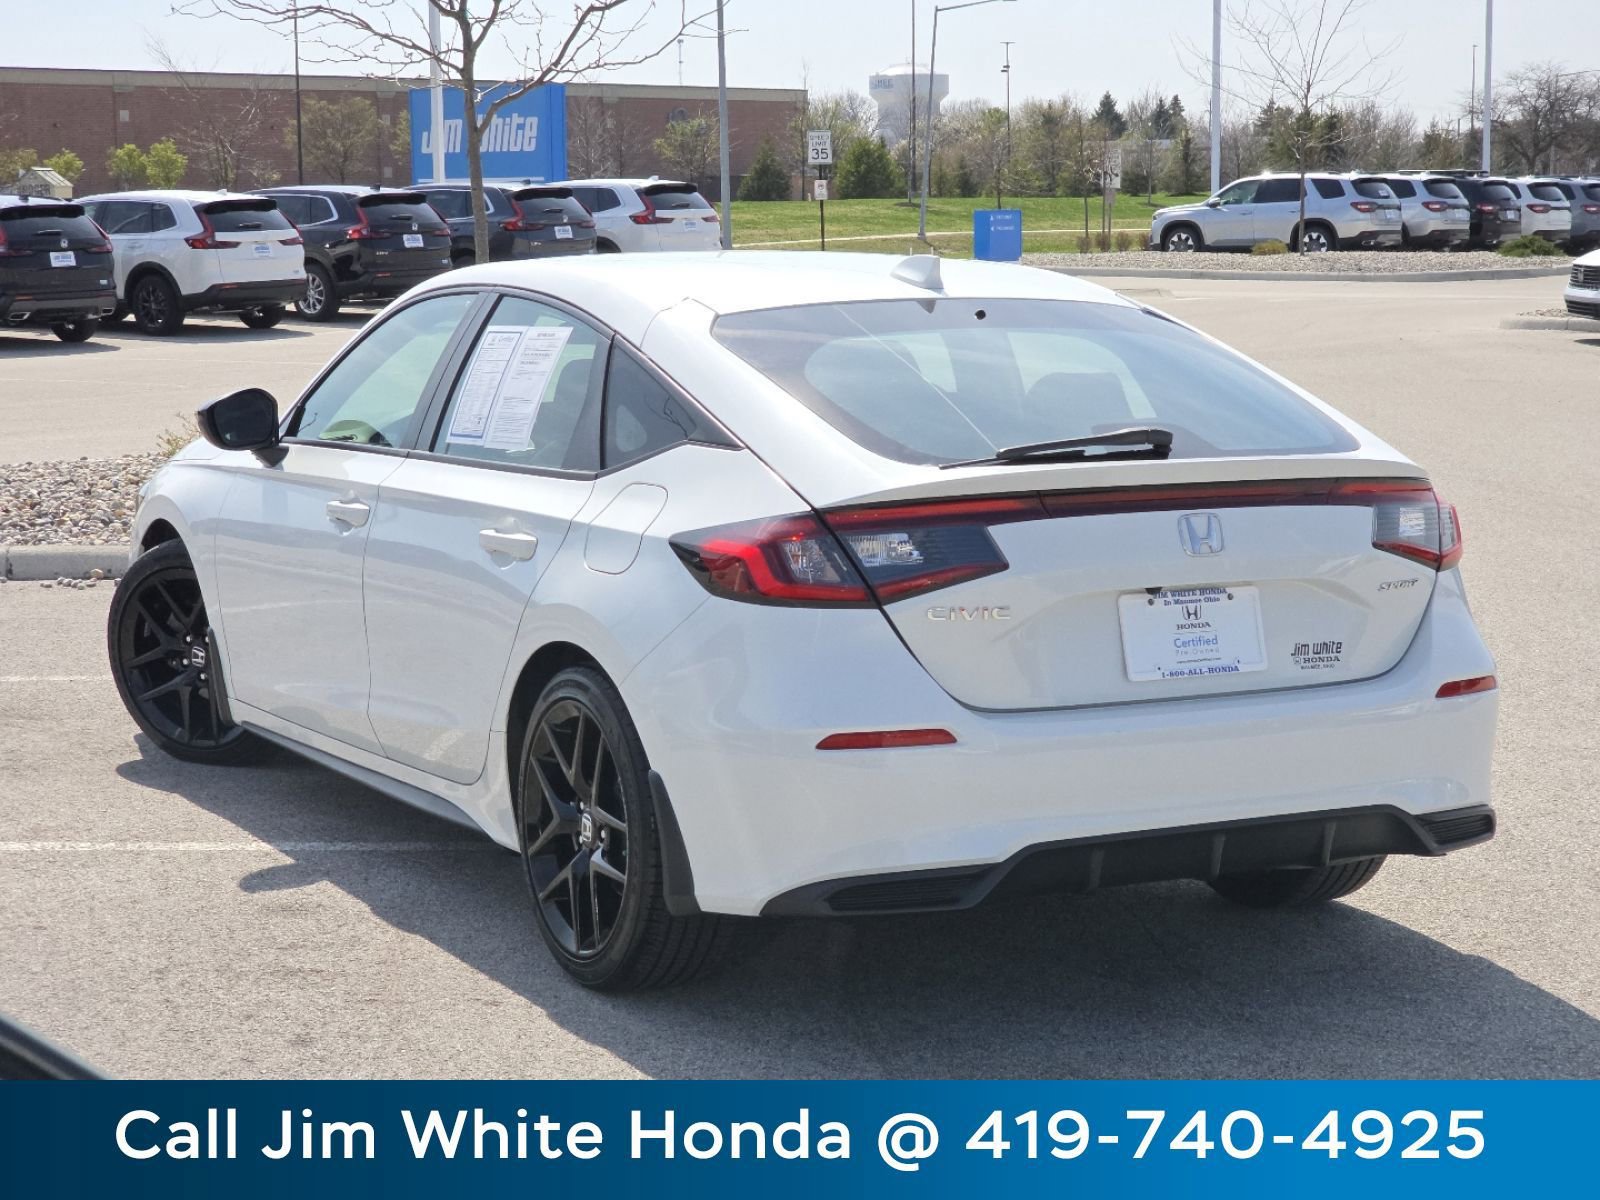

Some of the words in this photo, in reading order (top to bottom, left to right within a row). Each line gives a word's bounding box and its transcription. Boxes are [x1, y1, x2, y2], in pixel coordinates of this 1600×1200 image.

[421, 119, 463, 154] Jm
[811, 148, 829, 160] 35
[1153, 591, 1169, 599] JIM
[1170, 589, 1198, 598] WHITE
[1199, 587, 1228, 596] HONDA
[926, 605, 1011, 621] CIVIC
[1176, 621, 1212, 631] HONDA
[1174, 634, 1219, 649] Certified
[1303, 655, 1341, 664] HONDA
[1161, 665, 1241, 679] 1-800-ALL-HONDA
